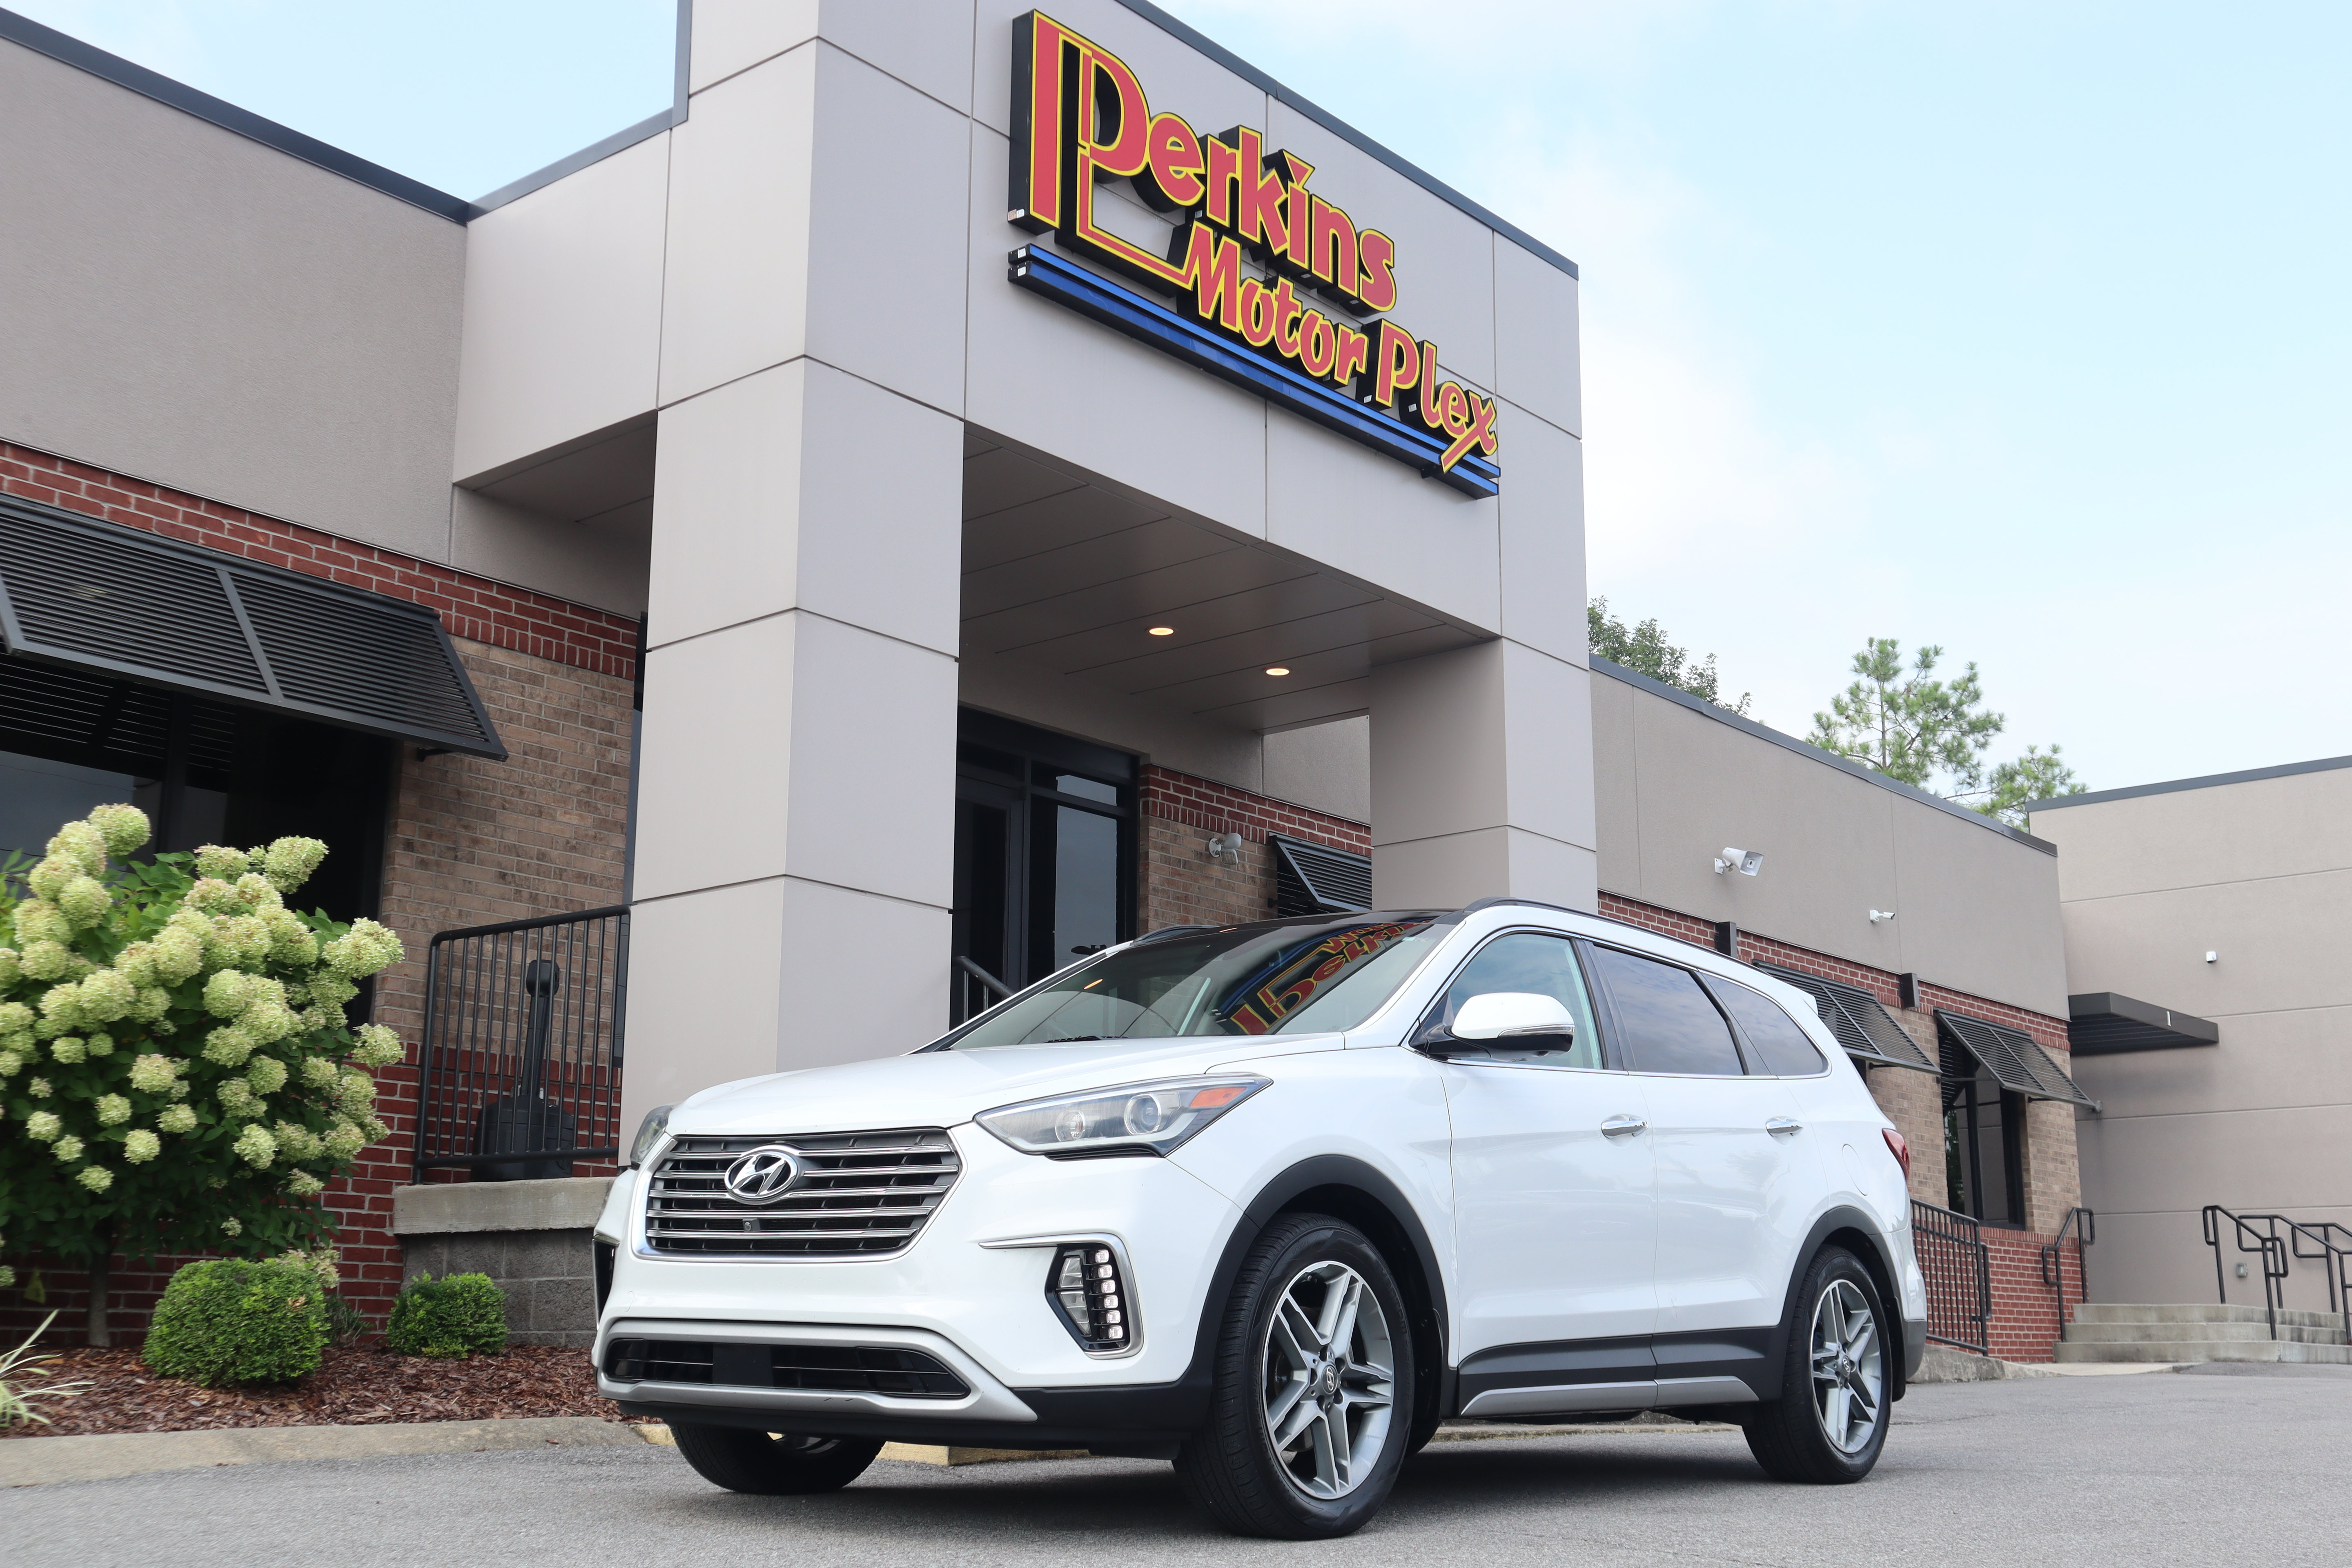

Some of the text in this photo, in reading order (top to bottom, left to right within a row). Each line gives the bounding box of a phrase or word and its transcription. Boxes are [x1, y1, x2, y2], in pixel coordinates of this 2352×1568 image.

[1029, 9, 1397, 312] Perkins
[1181, 220, 1498, 473] Motor Plex
